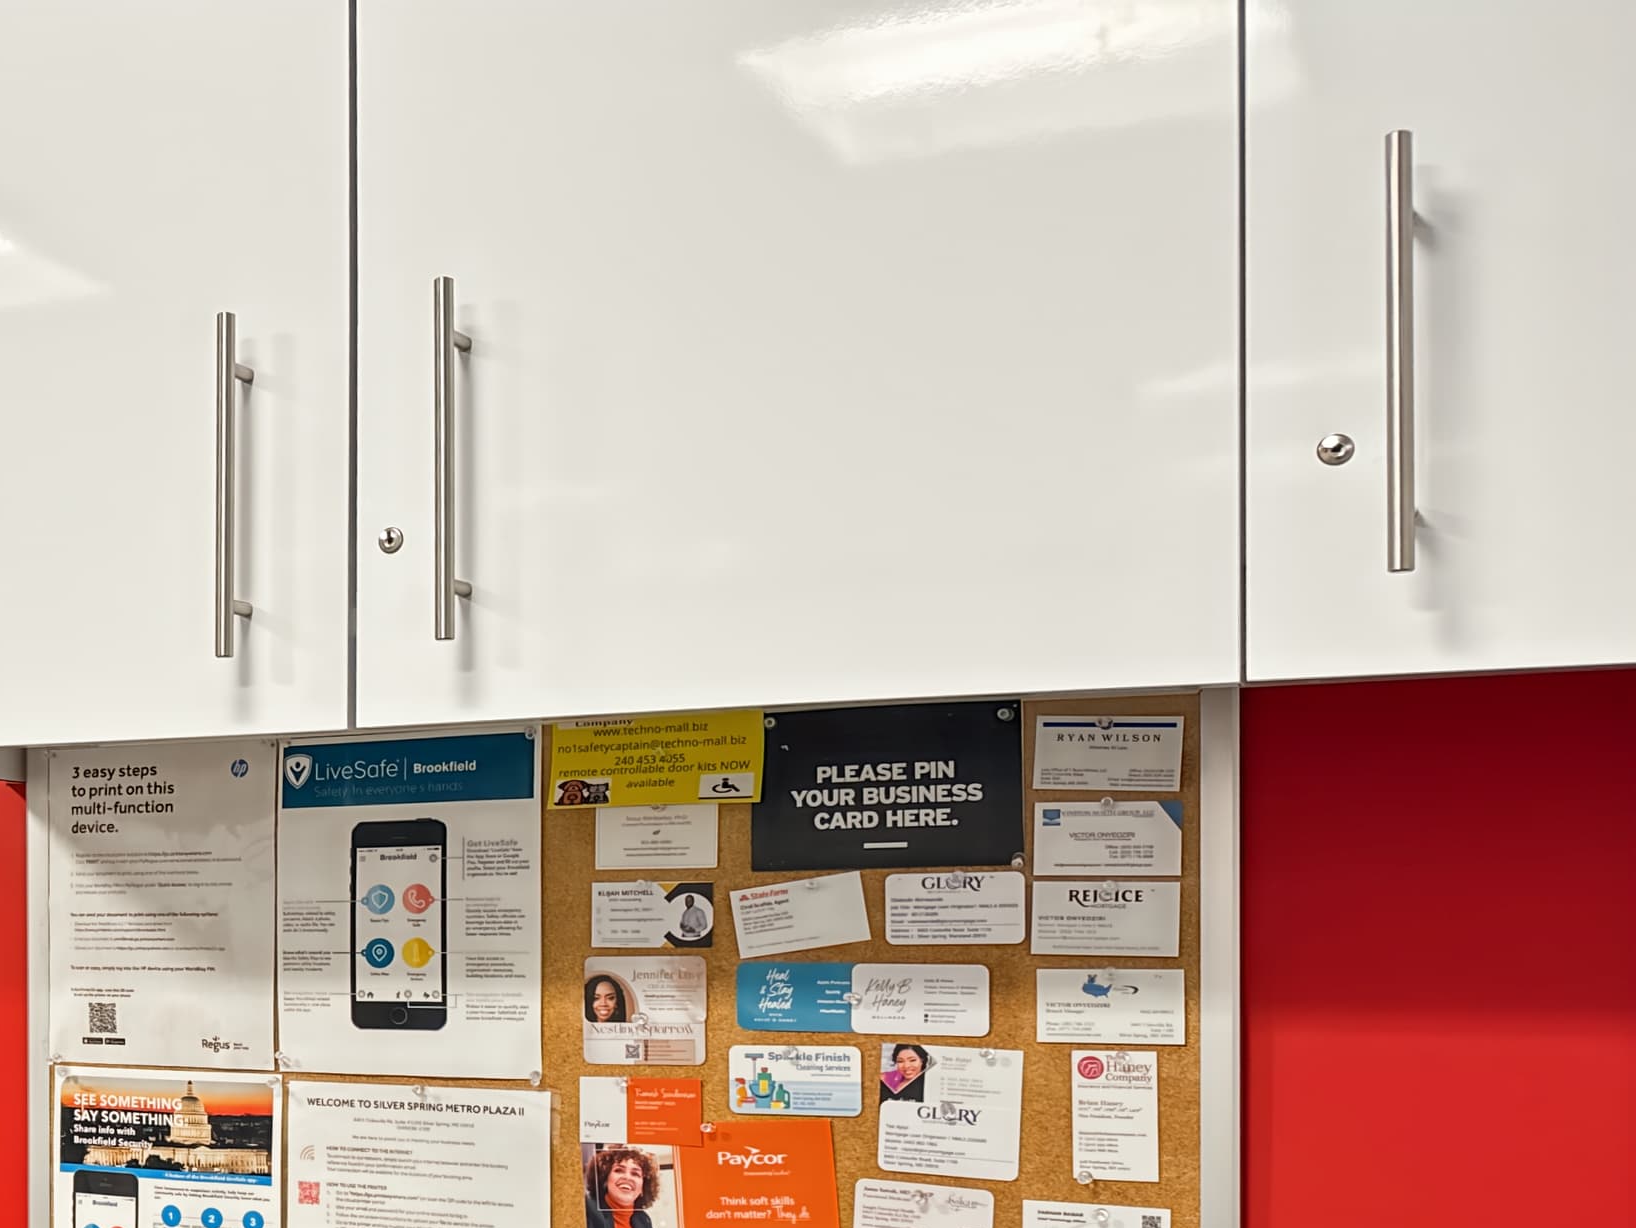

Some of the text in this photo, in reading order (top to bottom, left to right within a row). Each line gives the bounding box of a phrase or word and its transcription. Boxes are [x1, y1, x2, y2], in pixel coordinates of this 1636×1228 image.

[593, 722, 709, 738] www.techno-mall.biz
[1057, 733, 1162, 743] RYAN WILSON
[615, 756, 634, 766] 240
[637, 755, 656, 765] 453
[72, 764, 157, 781] 3 easy steps
[315, 758, 477, 781] LiveSafe Brookfield
[559, 760, 751, 778] remote controllable door kits NOW
[816, 760, 955, 784] PLEASE PIN
[71, 781, 175, 800] to print on this
[626, 778, 675, 788] available
[790, 783, 984, 808] YOUR BUSINESS
[71, 800, 174, 816] multi-function
[814, 808, 959, 830] CARD HERE.
[71, 821, 119, 834] device.
[202, 1038, 231, 1053] Regus
[768, 1051, 851, 1063] Spkle Finish
[73, 1092, 183, 1111] SEE SOMETHING
[307, 1097, 356, 1108] WELCOME
[358, 1099, 371, 1109] TO
[373, 1100, 406, 1111] SILVER
[407, 1102, 443, 1112] SPRING
[445, 1104, 480, 1114] METRO
[482, 1105, 517, 1116] PLAZA
[73, 1109, 99, 1123] SAY
[73, 1125, 136, 1136] Share info with
[73, 1135, 153, 1150] Brookfield Security
[717, 1151, 788, 1168] Paycor
[720, 1196, 795, 1206] Think soft skills
[208, 1214, 216, 1223] 2
[249, 1217, 257, 1226] 3
[706, 1210, 731, 1219] don't
[734, 1210, 772, 1219] matter?
